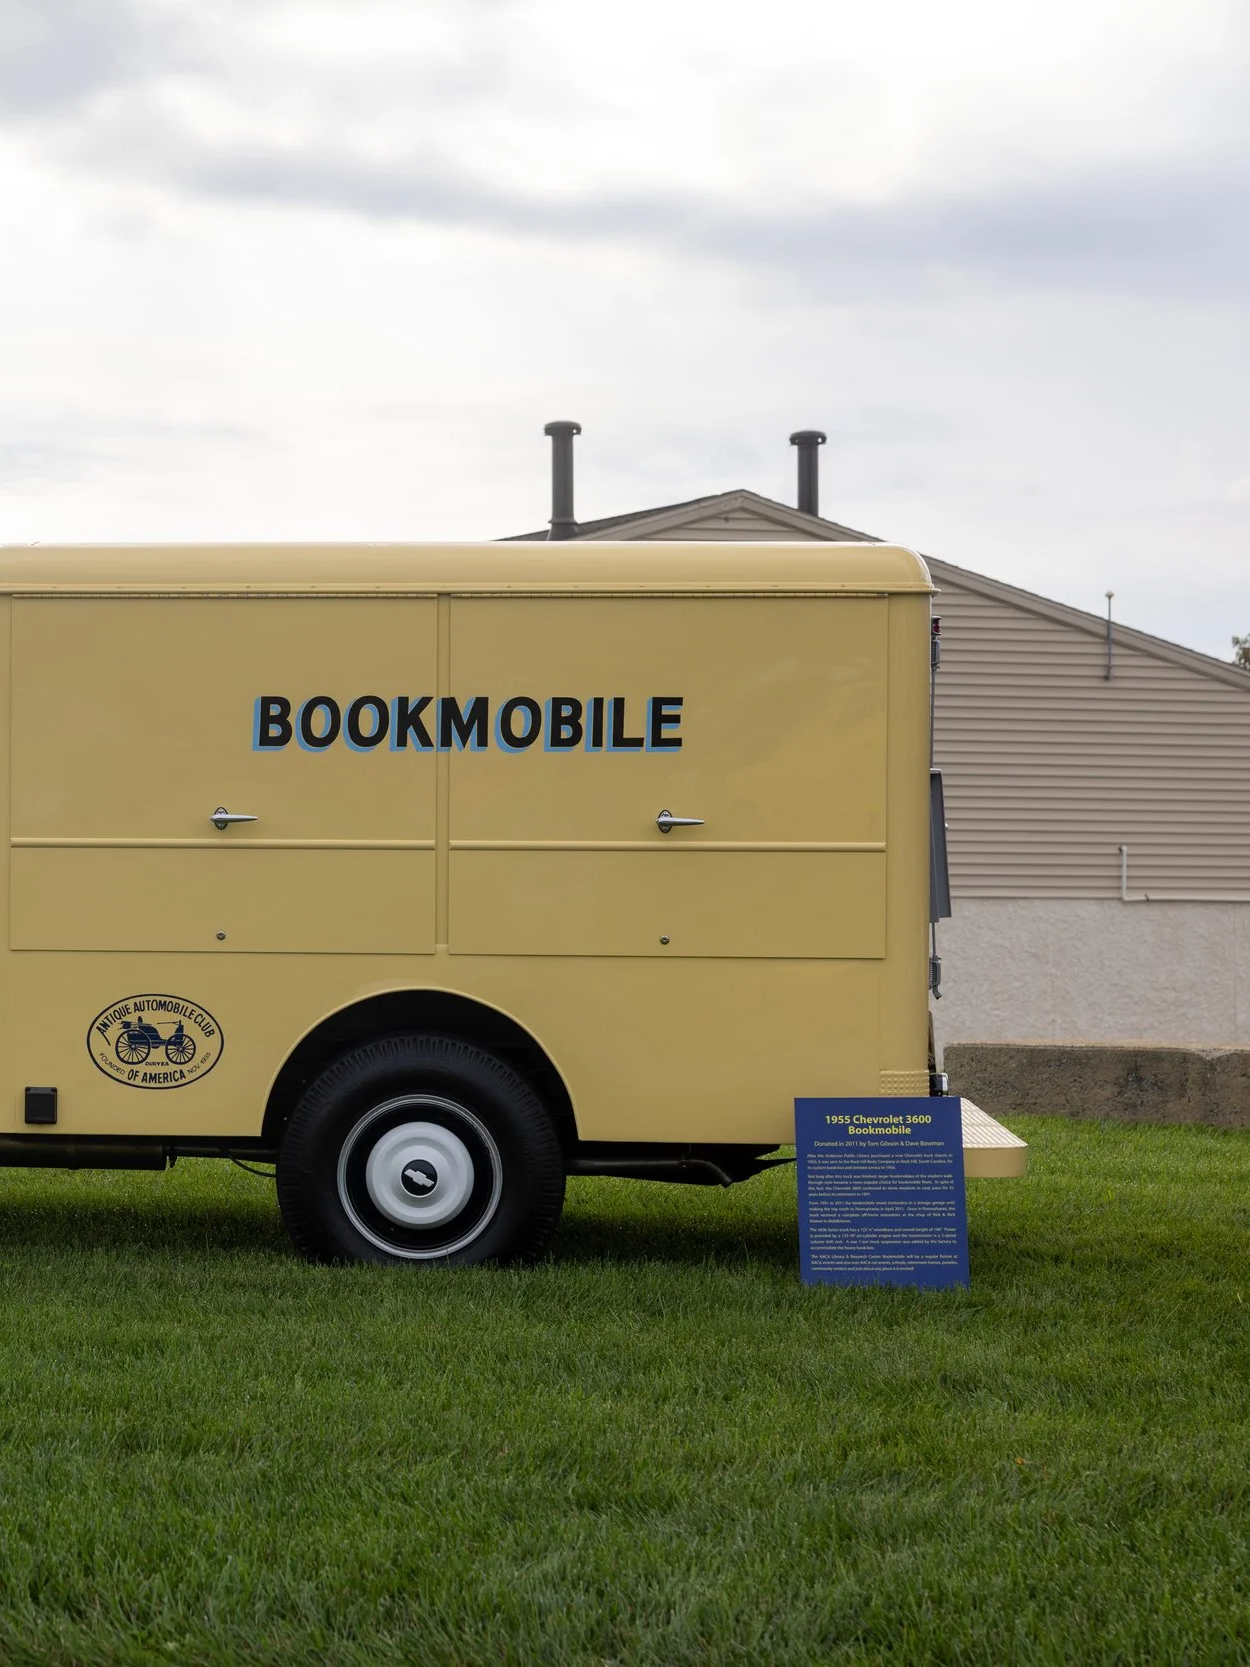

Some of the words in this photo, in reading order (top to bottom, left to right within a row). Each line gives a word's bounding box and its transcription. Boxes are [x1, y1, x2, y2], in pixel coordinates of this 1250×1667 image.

[252, 695, 684, 753] BOOKMOBILE
[96, 1004, 132, 1044] ANTIQUE
[133, 999, 196, 1020] AUTOMOBILE
[194, 1013, 216, 1038] CLUB
[99, 1052, 126, 1075] FOUNDED
[200, 1051, 212, 1065] 1935
[127, 1068, 140, 1081] OF
[141, 1069, 187, 1084] AMERICA
[825, 1115, 851, 1124] 1955
[852, 1115, 903, 1124] Chevrolet
[905, 1115, 932, 1124] 3600
[848, 1125, 912, 1135] Bookmobile
[859, 1140, 867, 1148] by
